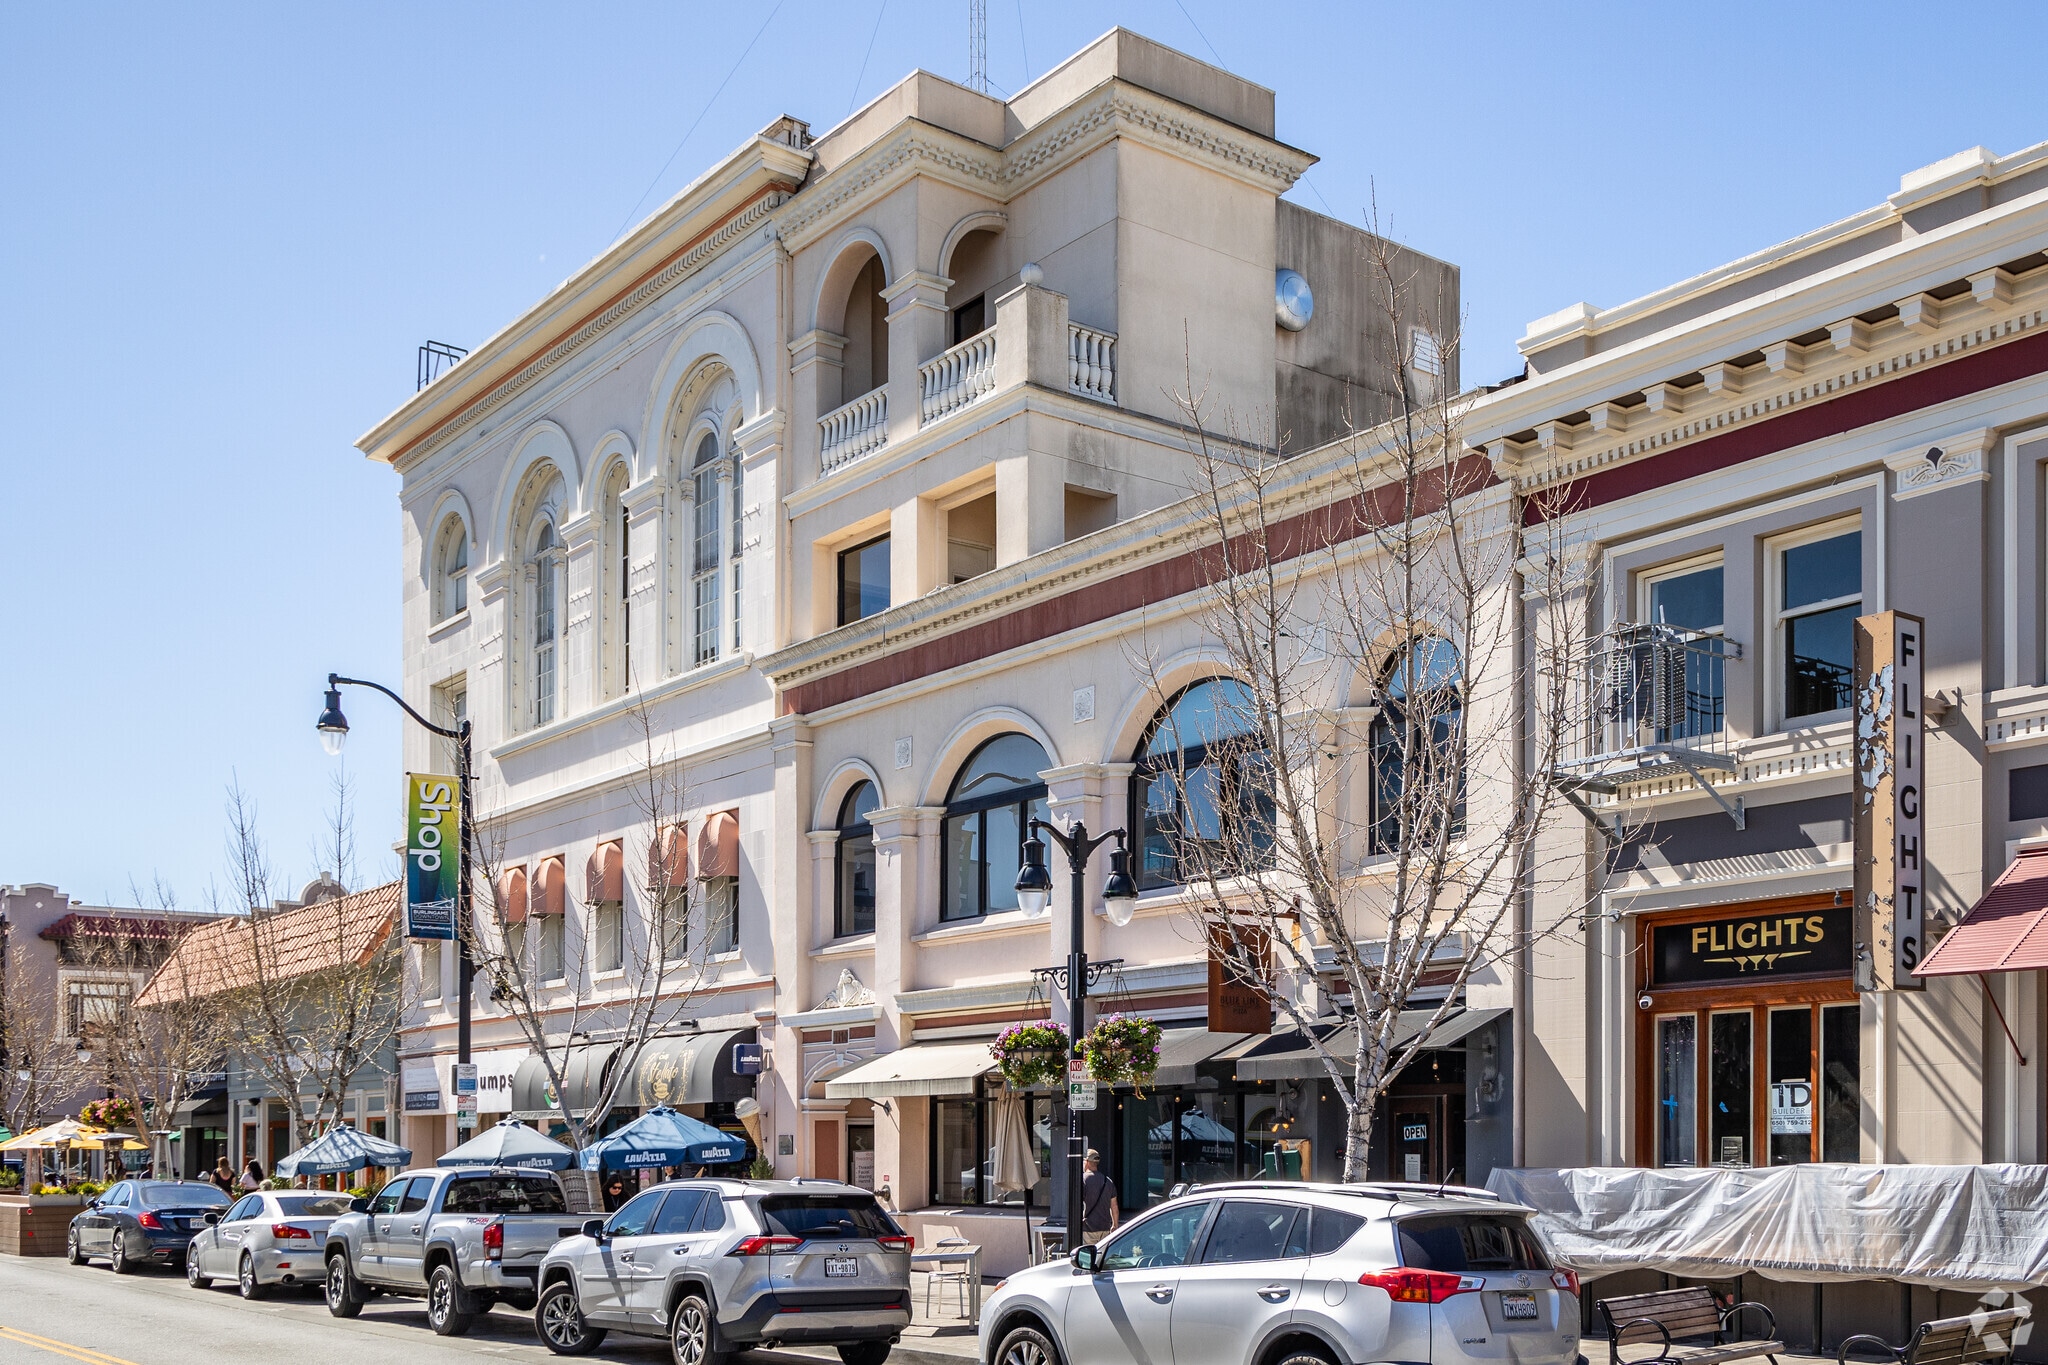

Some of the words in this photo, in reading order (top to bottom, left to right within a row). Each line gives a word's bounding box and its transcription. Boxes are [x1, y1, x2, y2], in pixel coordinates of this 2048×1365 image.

[1899, 632, 1918, 972] FLIGHTS
[409, 781, 451, 872] Shop
[1692, 915, 1824, 953] FLIGHTS
[1071, 1061, 1081, 1071] NO
[476, 1074, 514, 1093] umps
[1073, 1084, 1080, 1094] 2
[1772, 1084, 1812, 1107] TD
[1772, 1107, 1806, 1115] BUILDER
[1404, 1126, 1426, 1139] OPEN
[624, 1150, 667, 1164] LAVAZZA
[702, 1146, 731, 1158] LAVAZZA
[316, 1161, 351, 1171] LAVAZZA
[517, 1157, 554, 1167] LAVAZZA
[1504, 1303, 1536, 1317] 7MXH809
